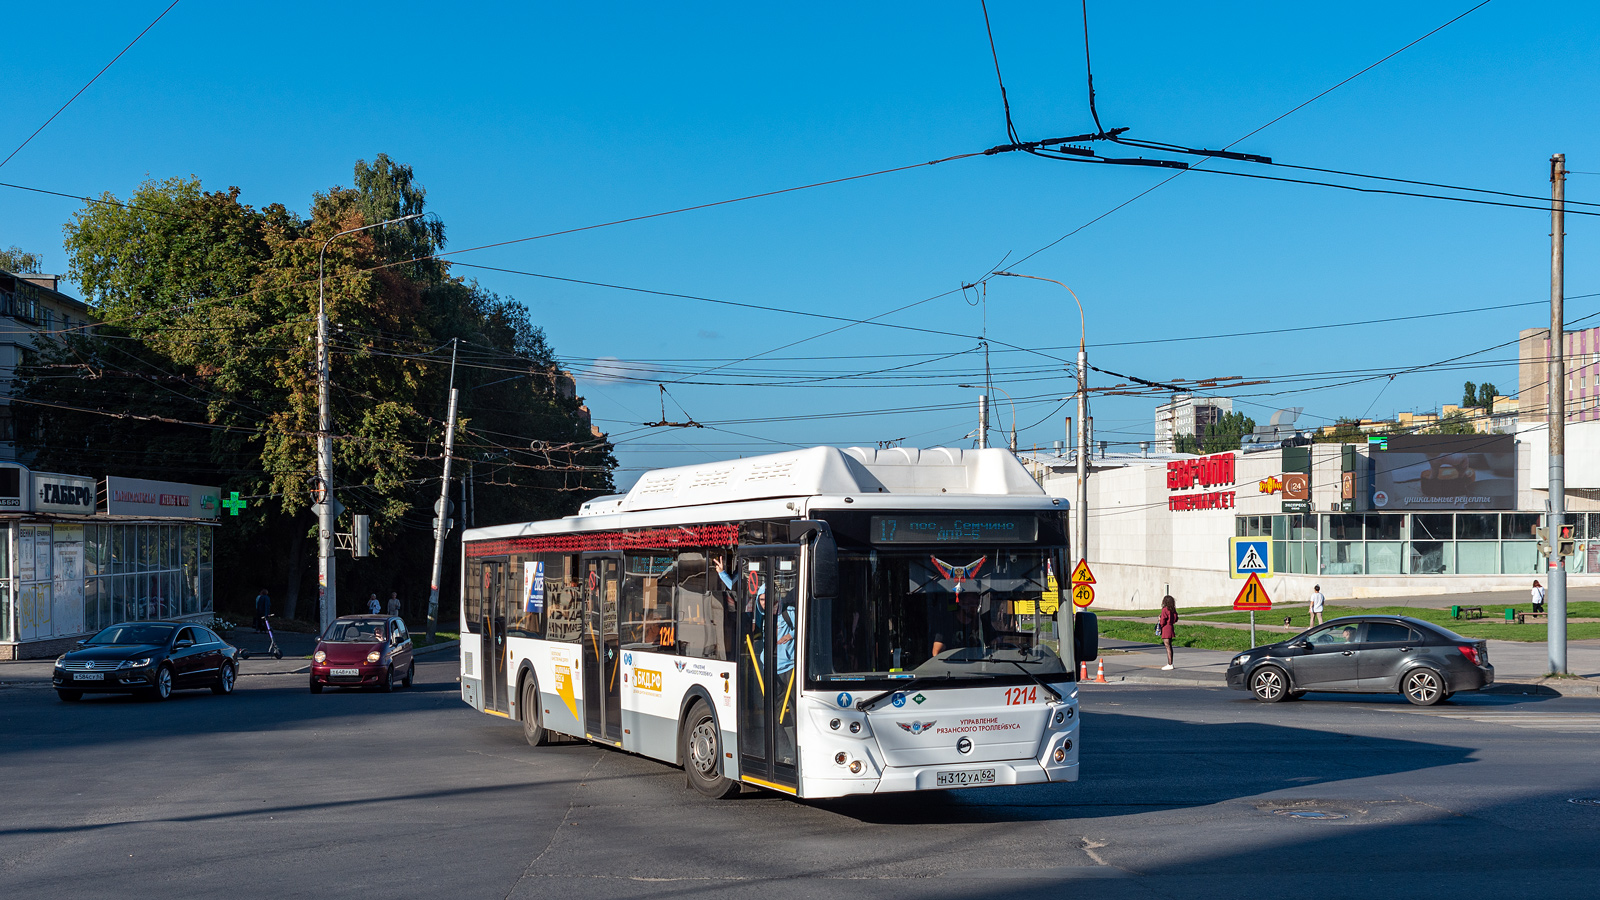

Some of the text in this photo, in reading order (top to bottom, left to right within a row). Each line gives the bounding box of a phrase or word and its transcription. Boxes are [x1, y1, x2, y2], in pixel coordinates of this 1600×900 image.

[43, 484, 90, 506] ГАББРО
[1454, 496, 1491, 505] рецепты
[881, 520, 897, 541] 17
[909, 520, 1014, 530] пос. Семчино
[937, 529, 980, 541] ДПР-5
[1076, 590, 1090, 600] 40
[660, 627, 674, 646] 1214
[637, 671, 661, 688] БКД.РФ
[1005, 686, 1037, 706] 1214
[960, 717, 998, 725] УПРАВЛЕНИЕ
[979, 723, 1020, 731] ТРОЛЛЕЙБУСА
[982, 770, 991, 778] 62
